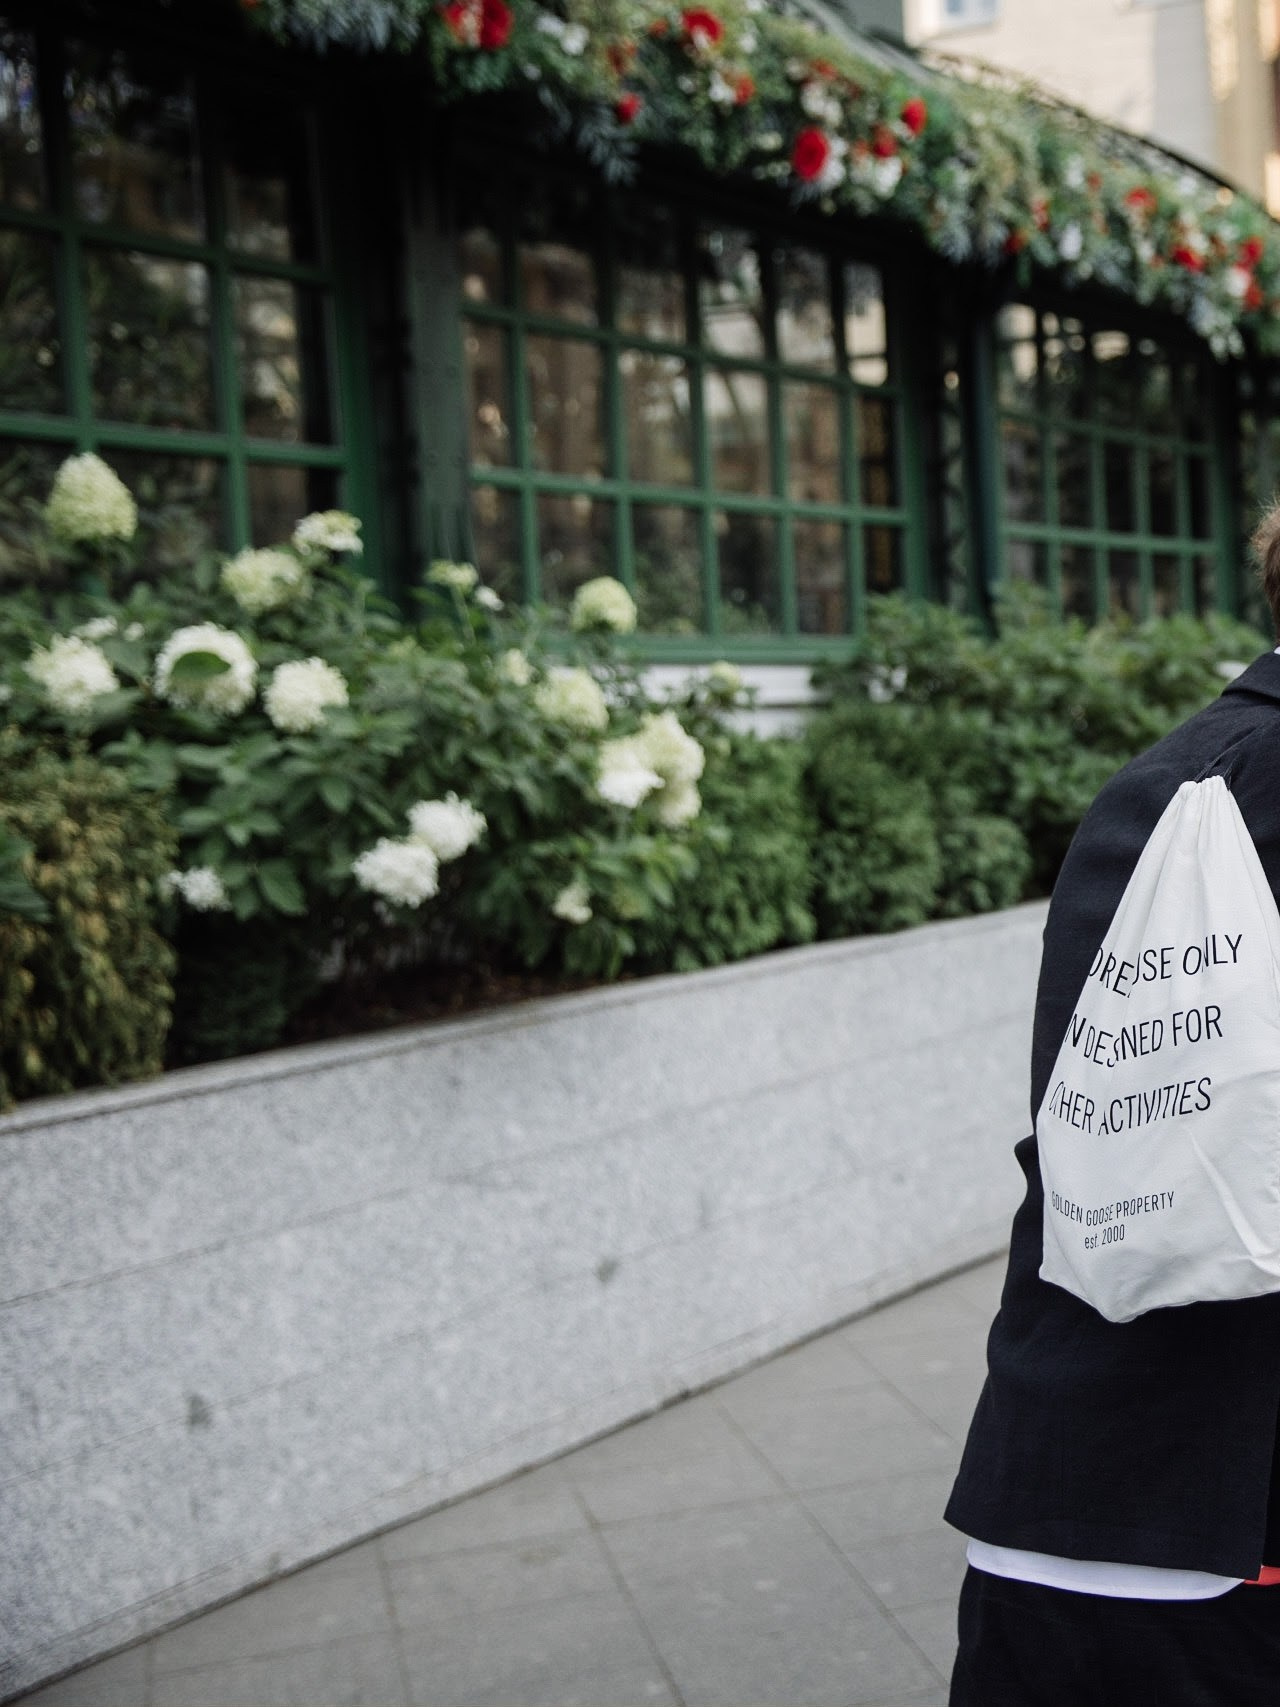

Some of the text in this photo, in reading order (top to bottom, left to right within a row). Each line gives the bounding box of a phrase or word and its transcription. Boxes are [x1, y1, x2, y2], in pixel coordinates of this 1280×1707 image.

[1182, 933, 1243, 976] ONLY
[1172, 1004, 1223, 1047] FOR
[1098, 1076, 1212, 1136] ACTIVITIES
[1051, 1190, 1175, 1227] GOLDEN GOOSE PROPERTY
[1084, 1224, 1125, 1250] est. 2000
